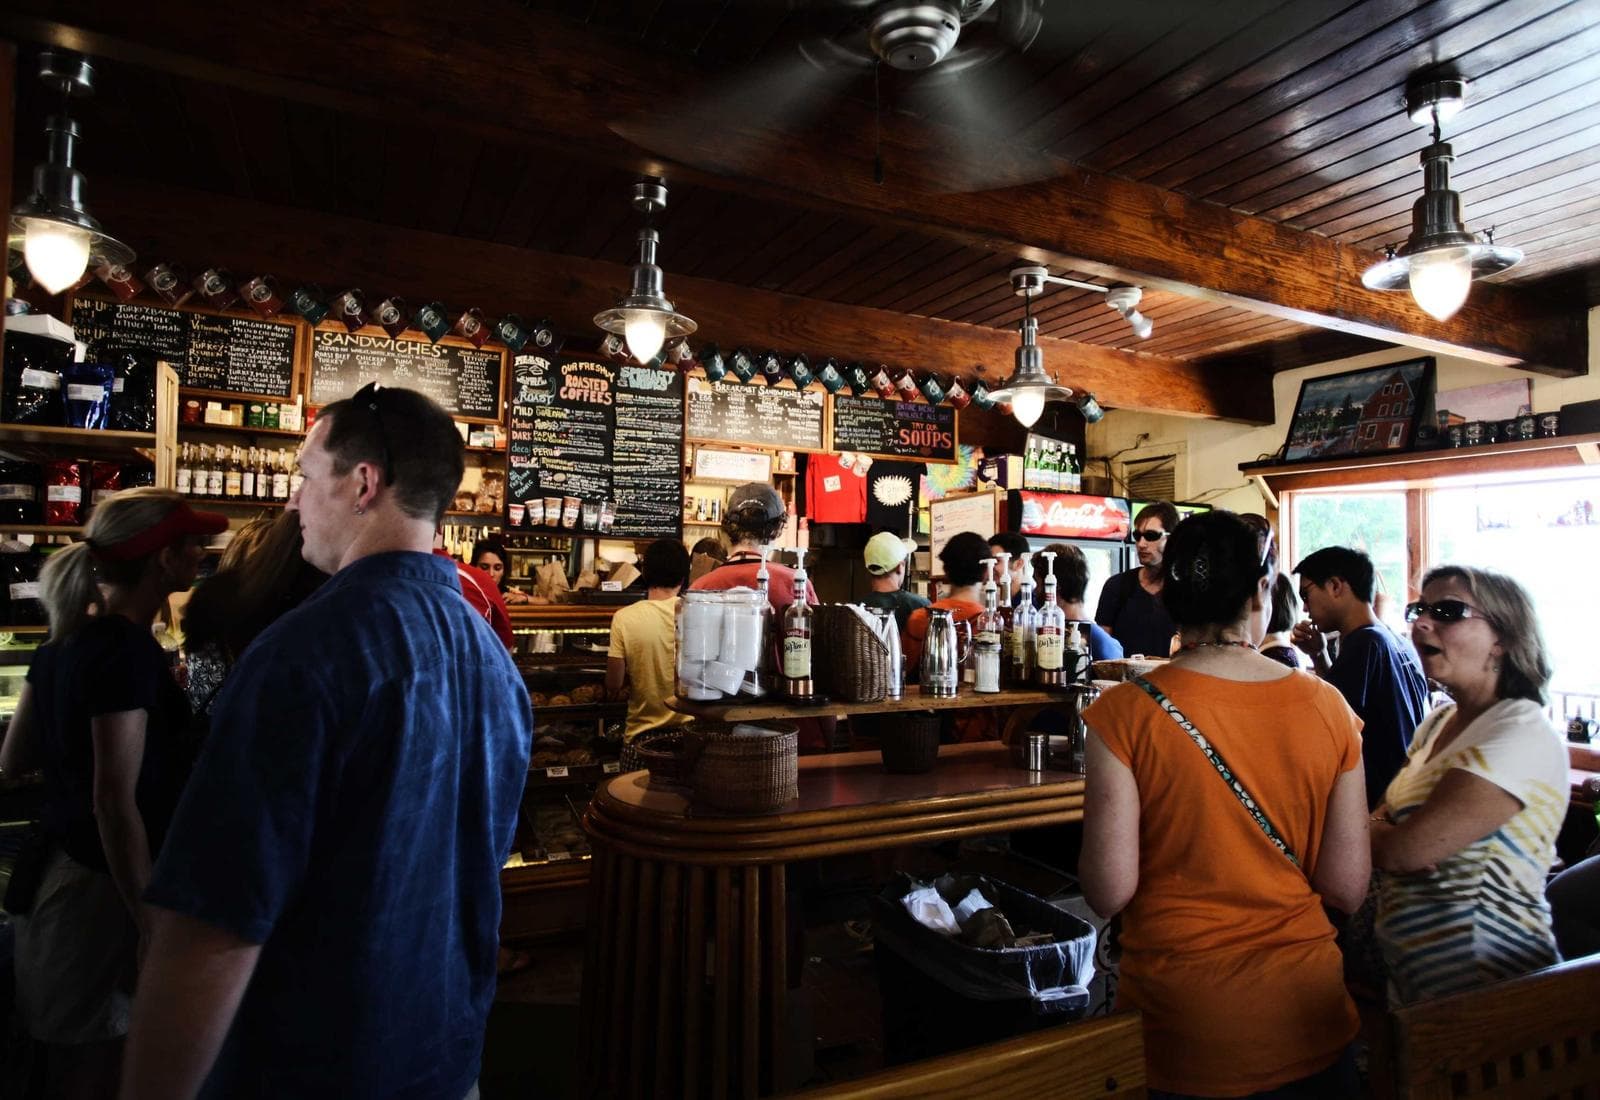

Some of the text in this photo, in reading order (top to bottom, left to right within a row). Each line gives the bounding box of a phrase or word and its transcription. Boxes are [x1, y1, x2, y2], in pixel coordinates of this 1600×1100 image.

[321, 332, 441, 358] SANDWICHES
[355, 354, 386, 363] CHICKEN
[561, 362, 578, 375] OUR
[578, 362, 616, 384] FRESHLY
[565, 374, 609, 392] ROASTED
[715, 381, 757, 394] BREAKFAST
[560, 386, 613, 406] COFFEES
[512, 405, 534, 417] MILD
[911, 421, 924, 430] TRY
[511, 430, 533, 441] DARK
[899, 428, 953, 449] SOUPS
[532, 447, 554, 457] PERU
